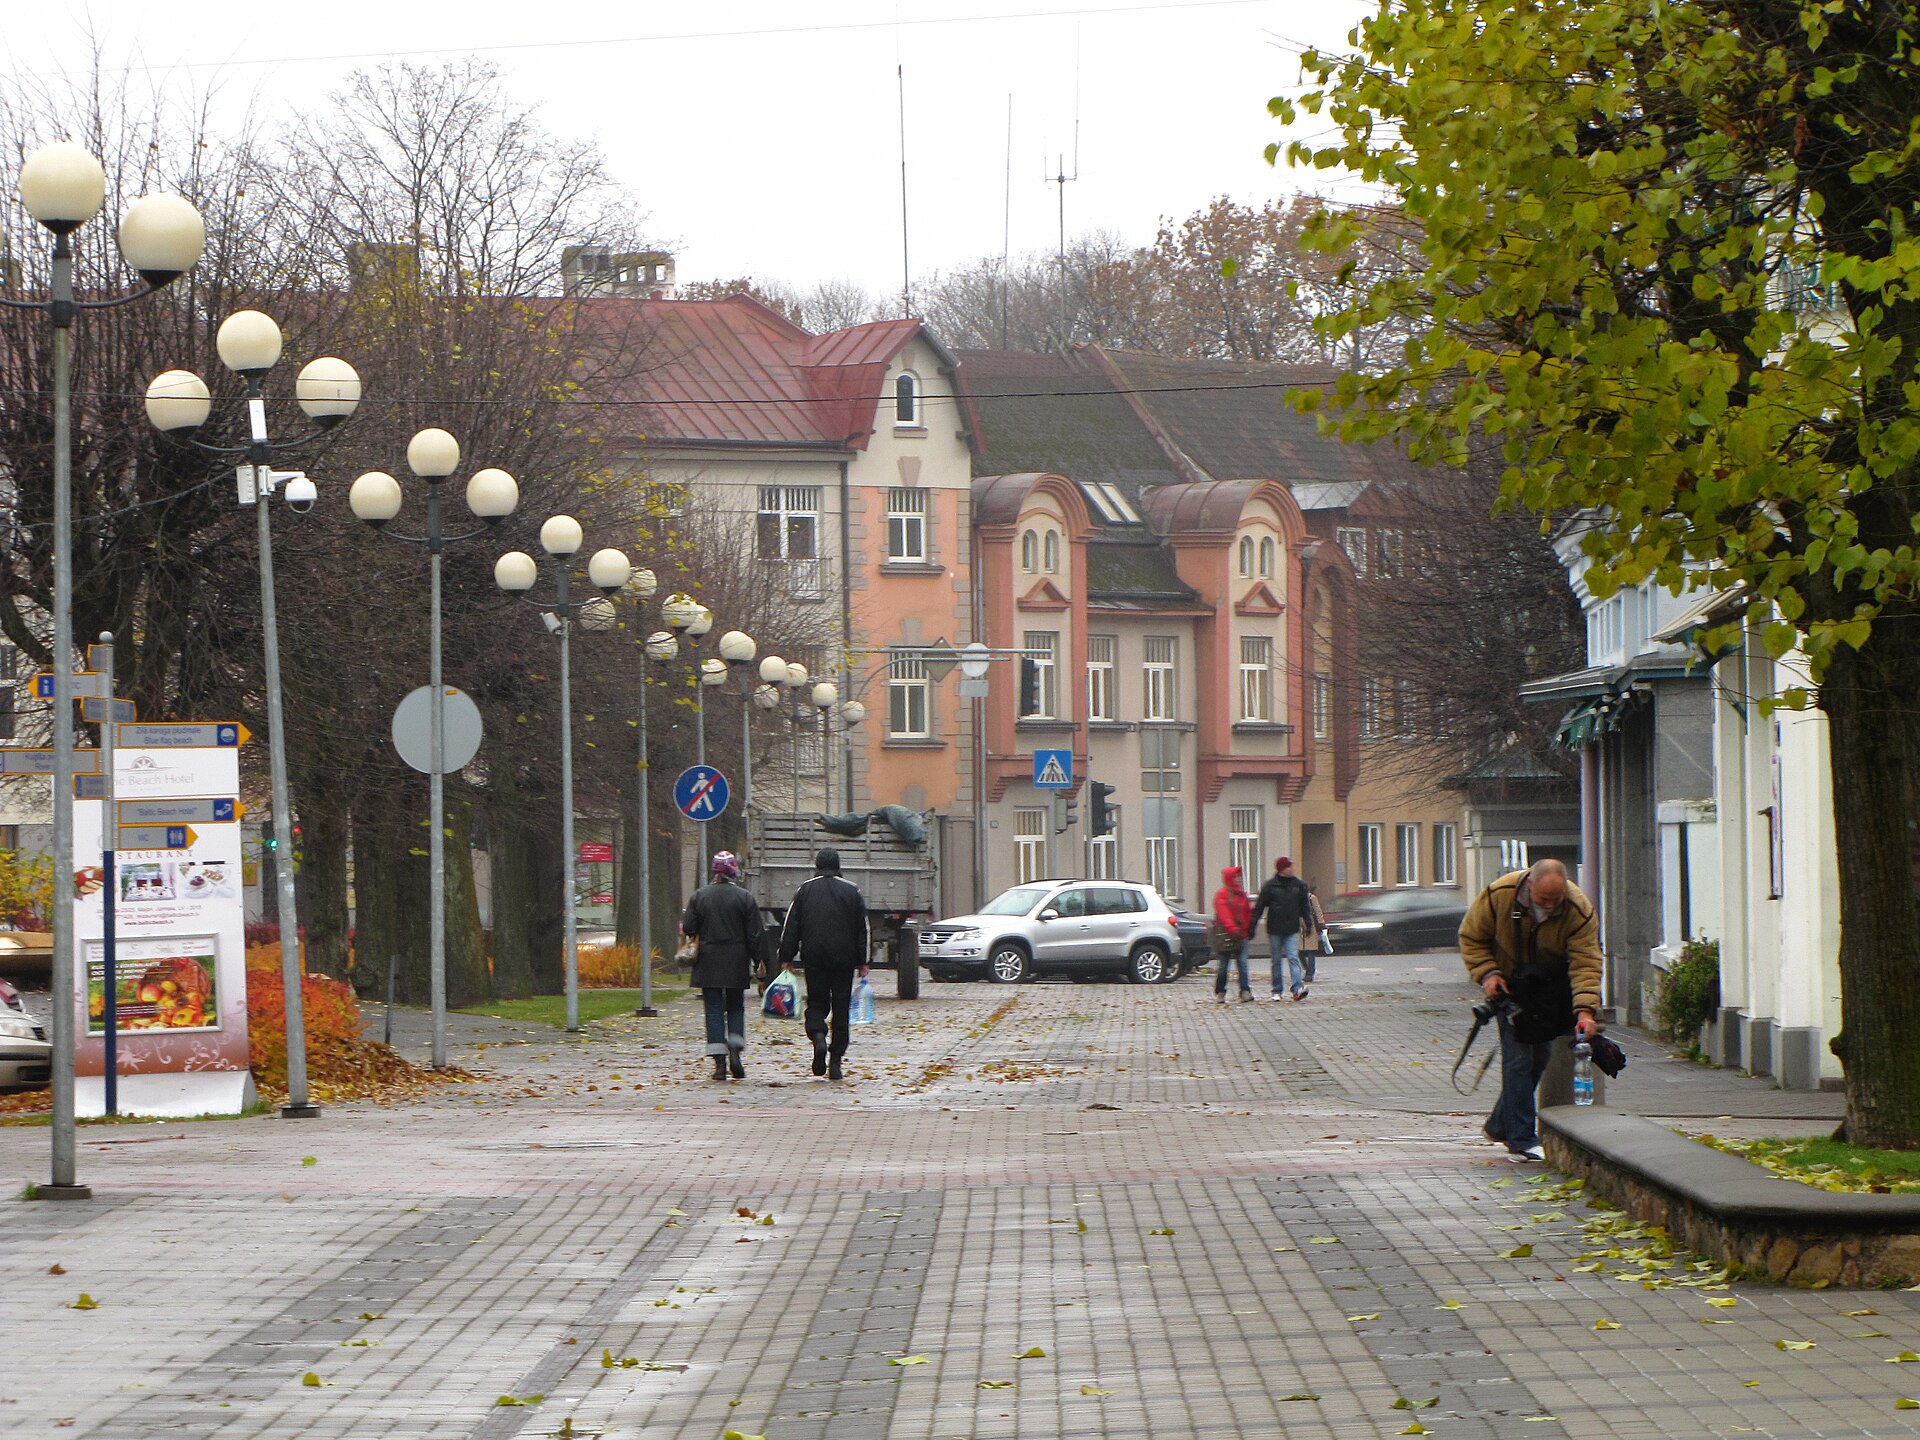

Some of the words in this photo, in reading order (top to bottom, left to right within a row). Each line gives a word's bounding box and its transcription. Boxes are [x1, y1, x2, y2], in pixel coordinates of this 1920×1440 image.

[128, 775, 160, 786] Beach
[165, 773, 194, 784] Hotel
[99, 849, 193, 861] RSTAURANT
